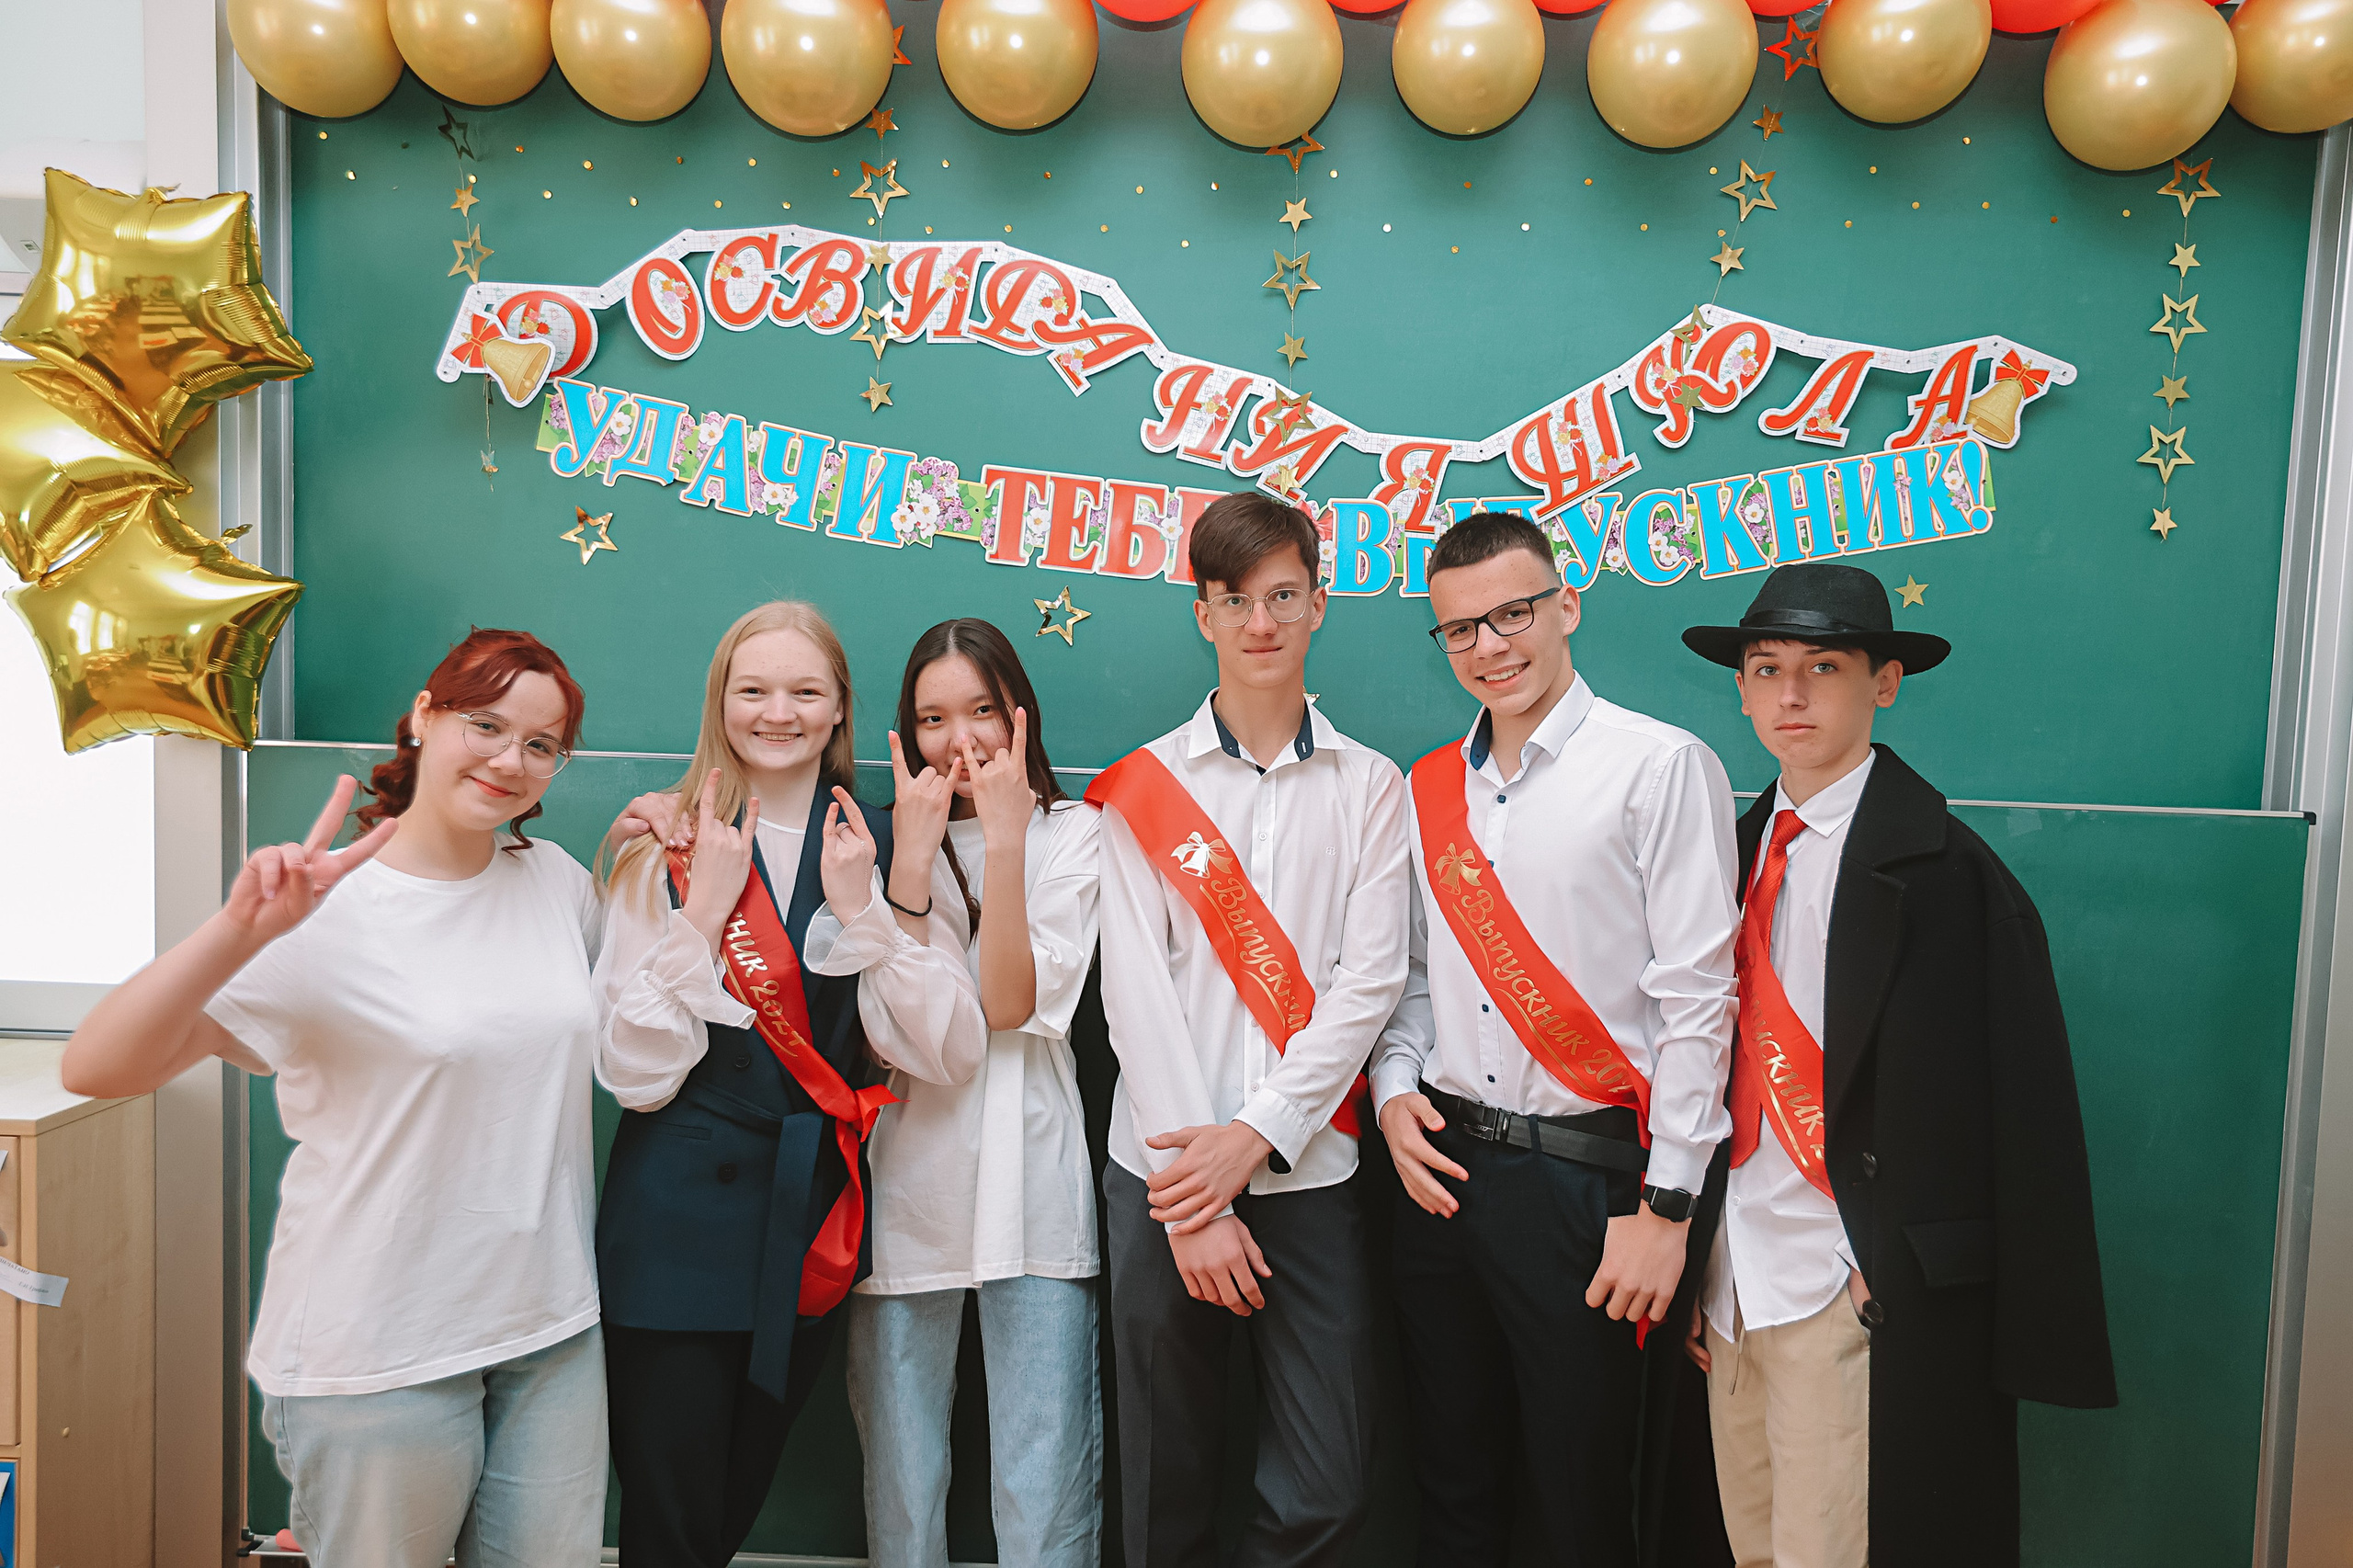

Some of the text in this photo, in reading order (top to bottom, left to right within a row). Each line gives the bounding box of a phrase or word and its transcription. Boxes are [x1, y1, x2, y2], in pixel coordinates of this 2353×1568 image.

[551, 380, 915, 544] УДАЧИ
[1329, 440, 1988, 594] ВУСКНИК!
[710, 233, 1453, 533] СВИДАНИЯ
[1511, 321, 1980, 518] ШКОЛА
[1460, 888, 1590, 1056] Выпускник
